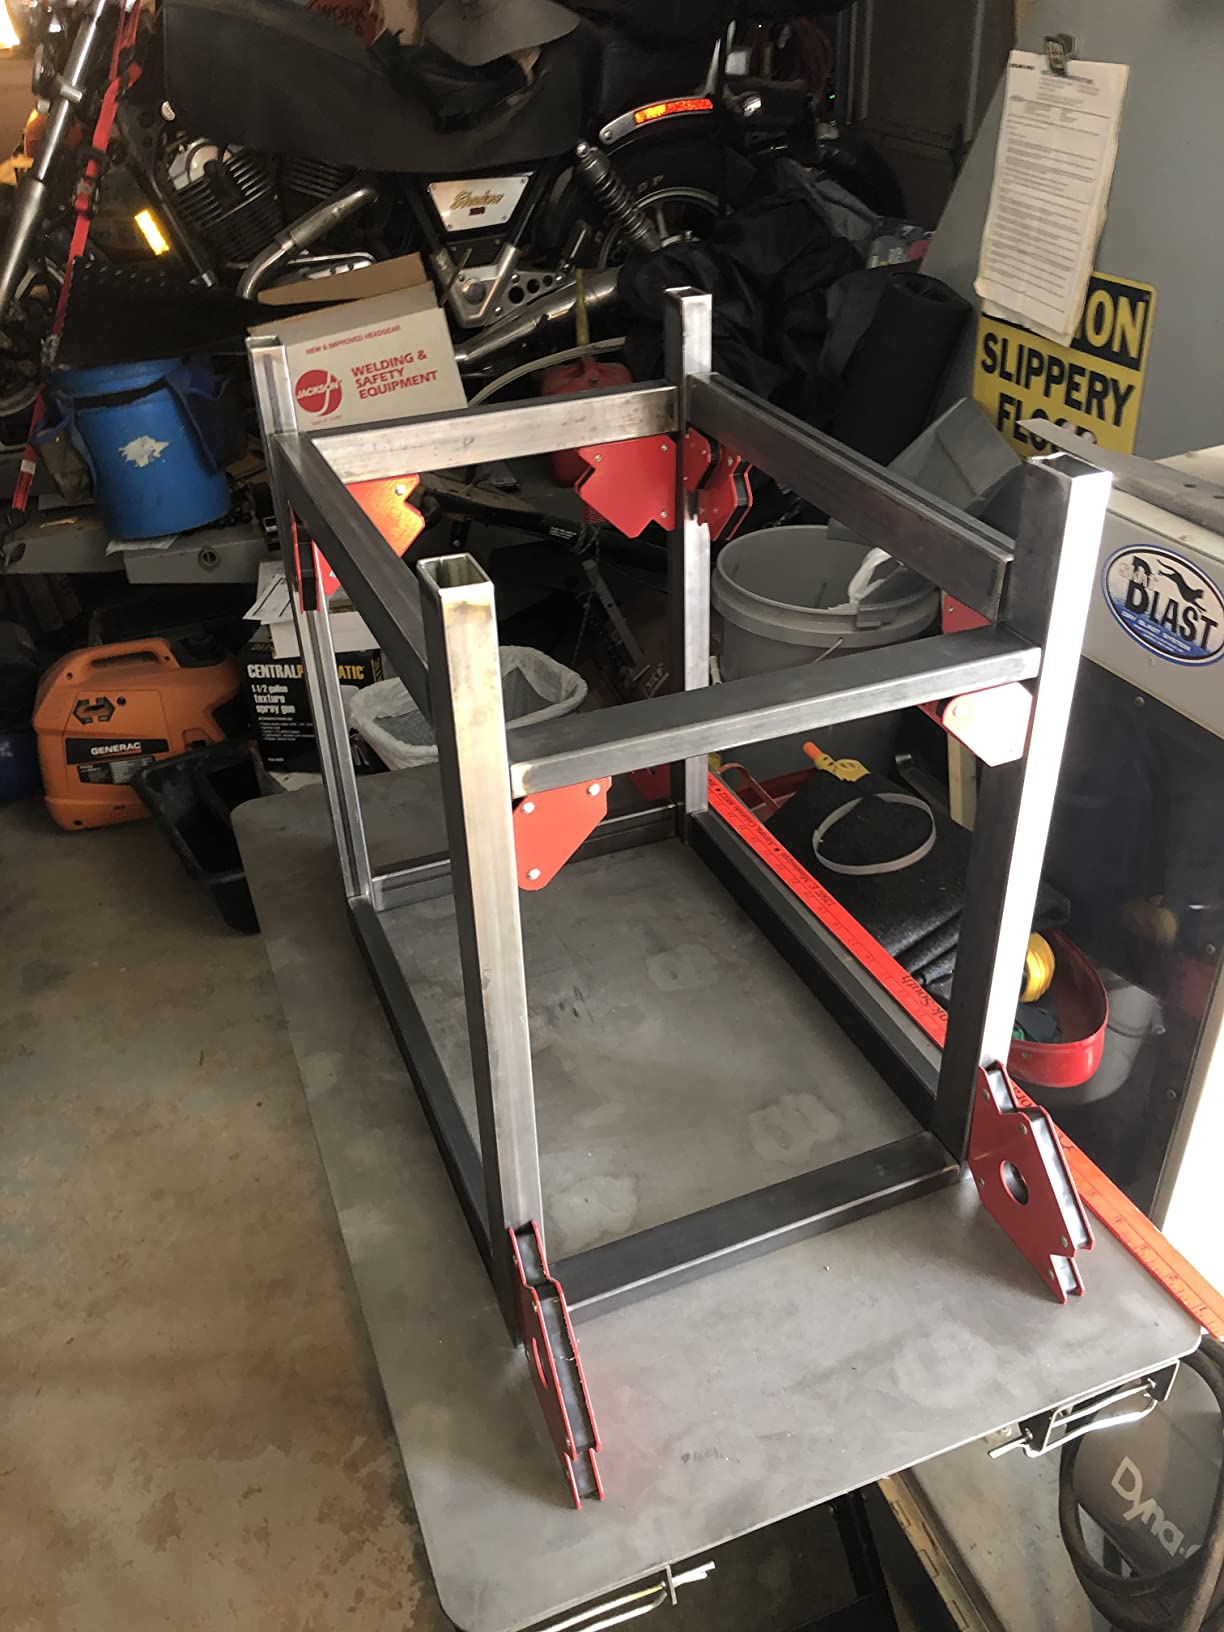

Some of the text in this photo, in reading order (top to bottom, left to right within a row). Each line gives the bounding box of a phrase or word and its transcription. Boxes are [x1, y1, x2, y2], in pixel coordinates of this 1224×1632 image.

[352, 350, 428, 377] WELDING &
[354, 367, 406, 389] SAFETY
[358, 370, 439, 399] EQUIPMENT
[981, 332, 1136, 428] SLIPPERY
[1124, 555, 1219, 650] BLAST
[253, 694, 286, 703] texture
[256, 705, 296, 715] spray gun
[91, 742, 141, 755] GENERAC
[902, 975, 930, 1007] South
